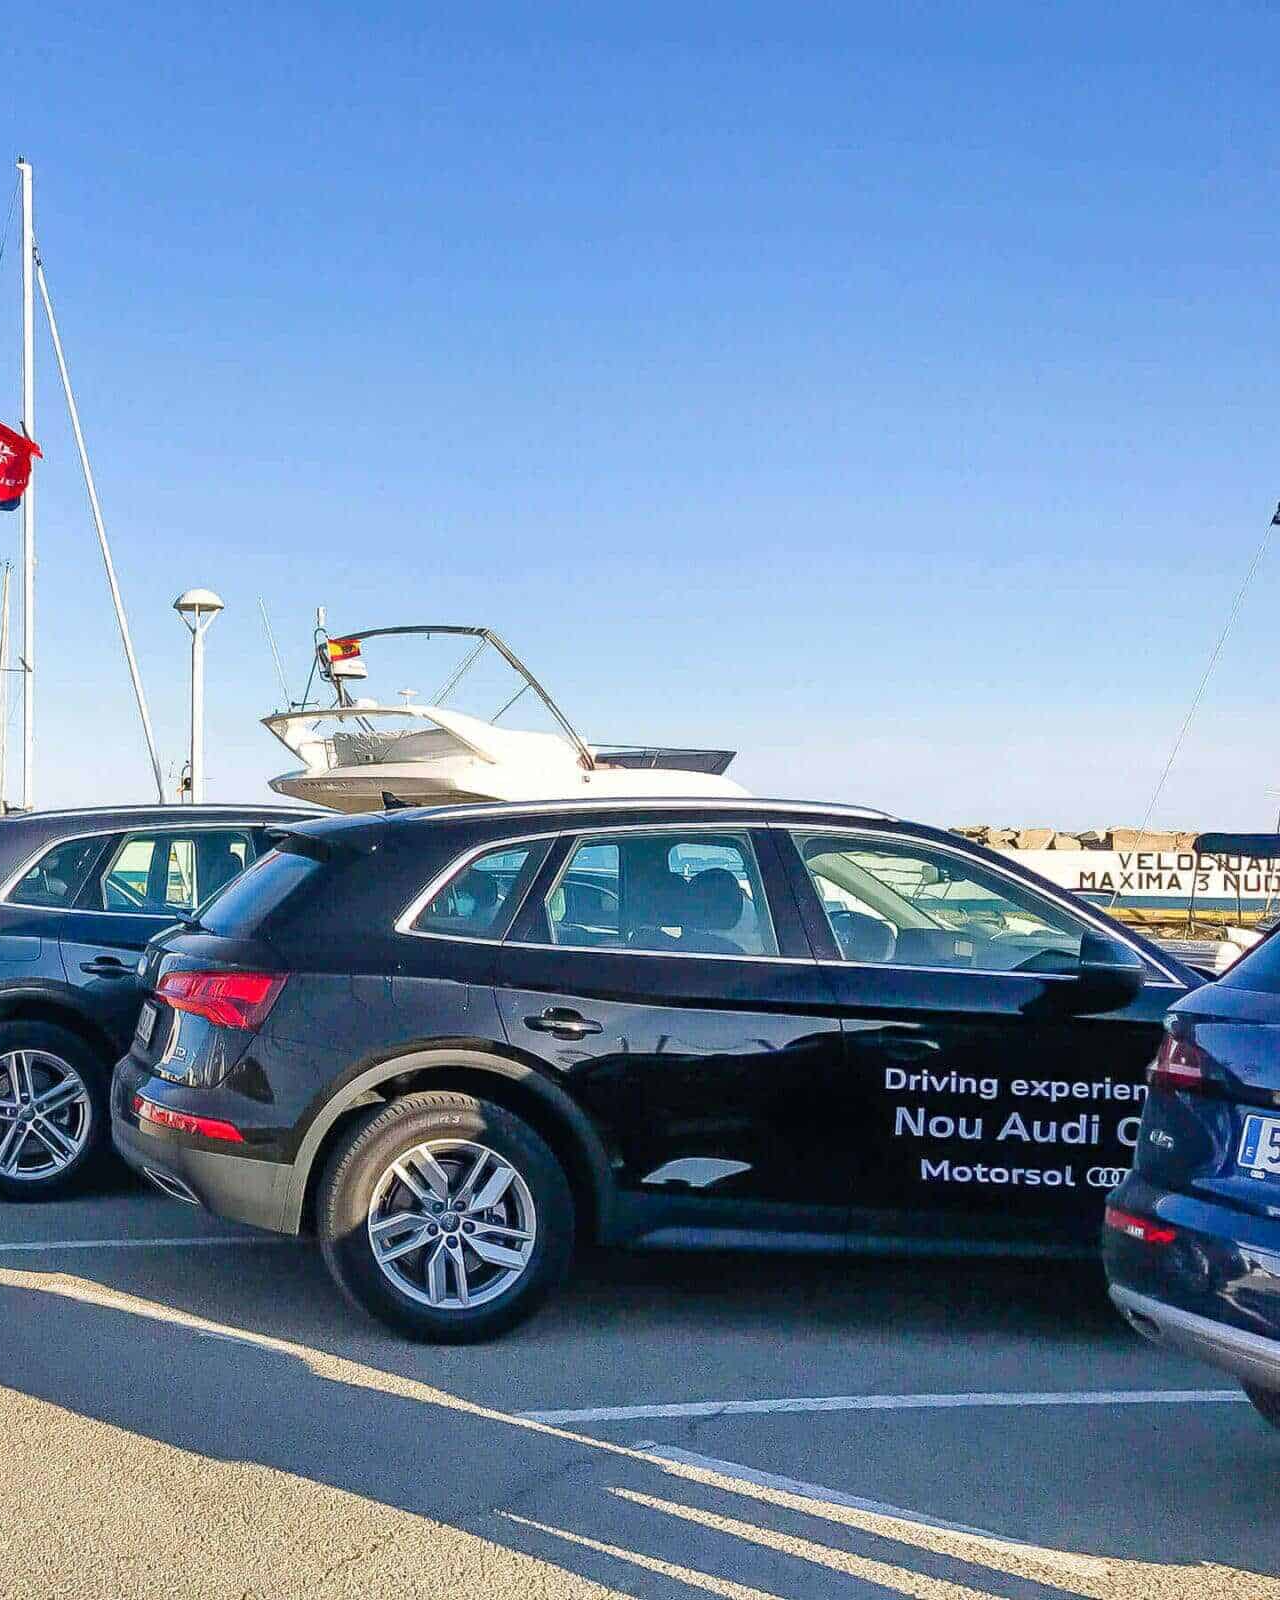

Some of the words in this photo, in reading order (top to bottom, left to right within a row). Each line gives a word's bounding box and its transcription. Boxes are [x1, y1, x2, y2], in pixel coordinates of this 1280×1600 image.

[1079, 870, 1182, 891] MAXIMA
[1197, 873, 1211, 891] 3
[1223, 873, 1280, 892] NUD
[884, 1067, 999, 1100] Driving
[1010, 1077, 1149, 1102] experien
[894, 1106, 982, 1139] Nou
[996, 1111, 1099, 1145] Audi
[920, 1158, 1076, 1187] Motorsol
